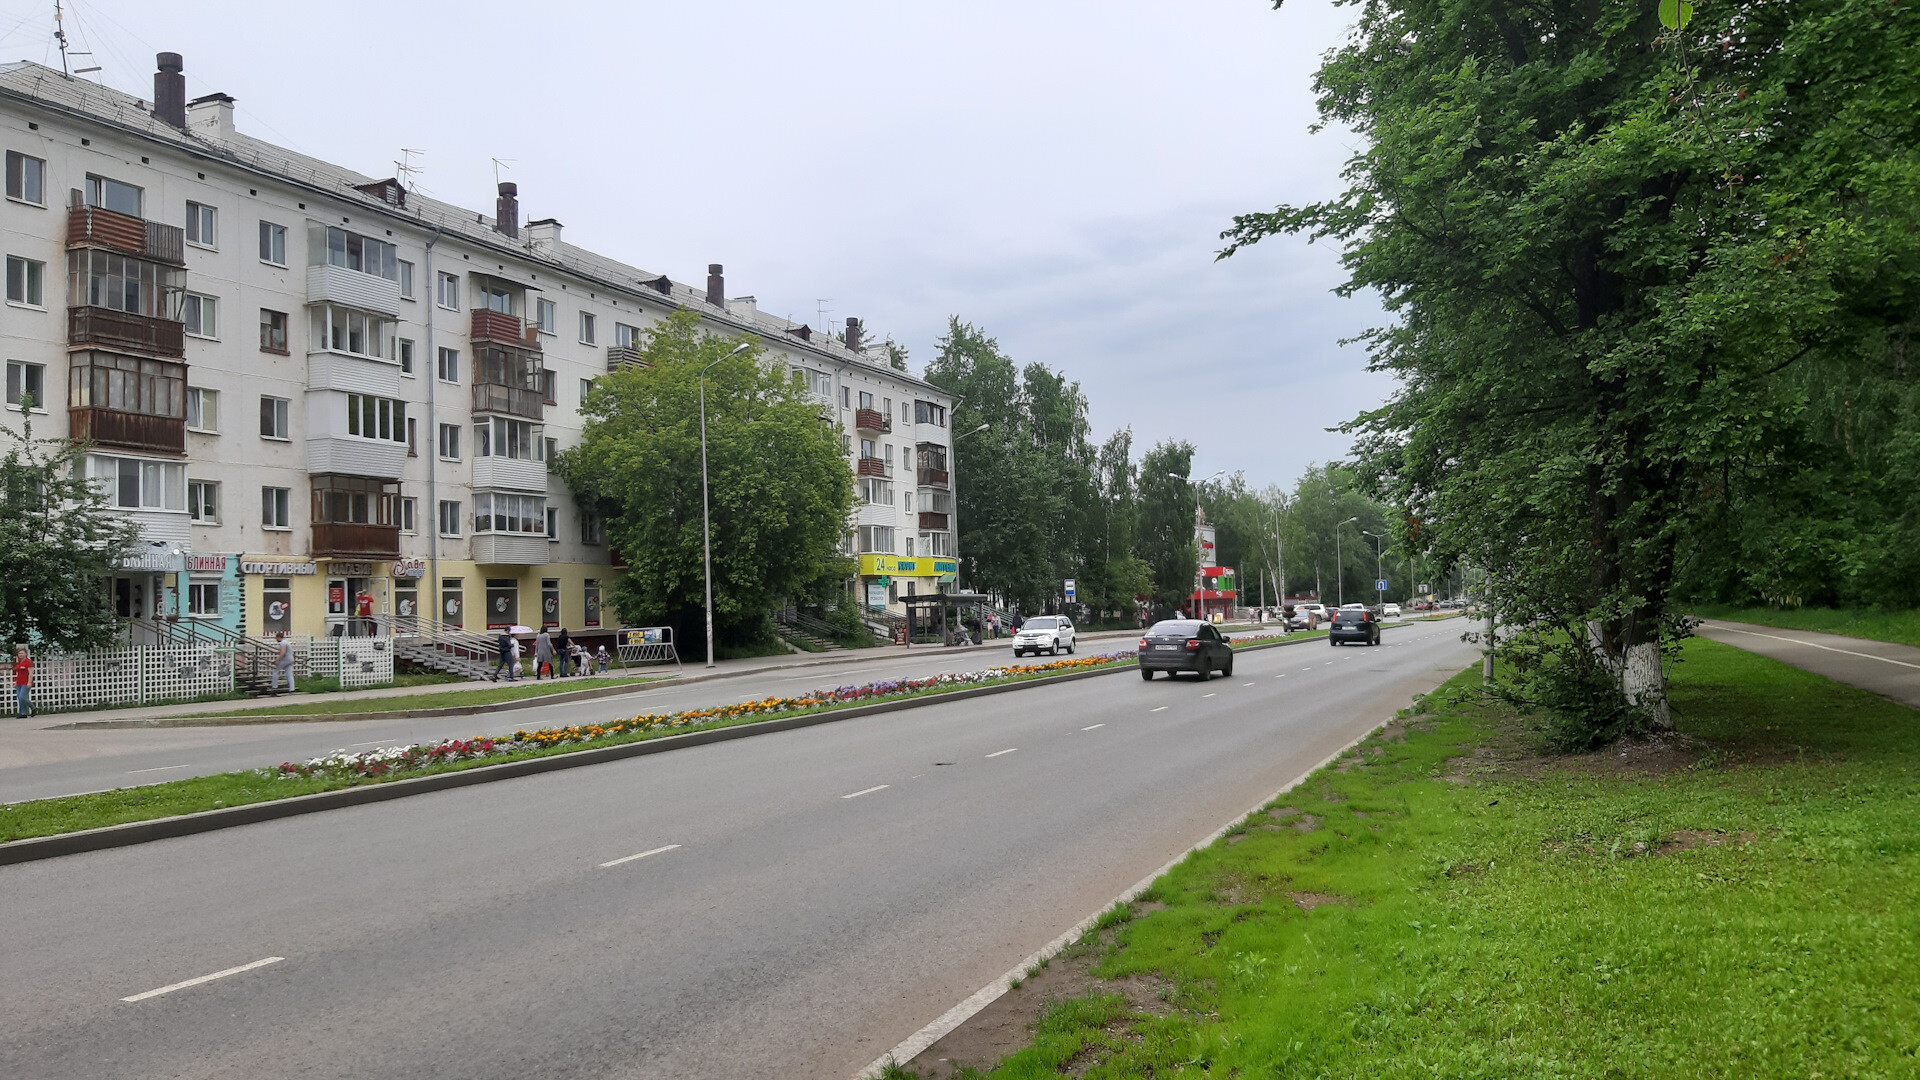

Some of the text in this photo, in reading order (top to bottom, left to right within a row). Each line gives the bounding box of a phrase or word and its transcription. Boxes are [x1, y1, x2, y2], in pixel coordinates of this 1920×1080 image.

[187, 556, 226, 570] БЛИННАЯ
[242, 561, 372, 575] СПОРТИВНЫЙ МАГАЗИН
[876, 558, 885, 571] 24
